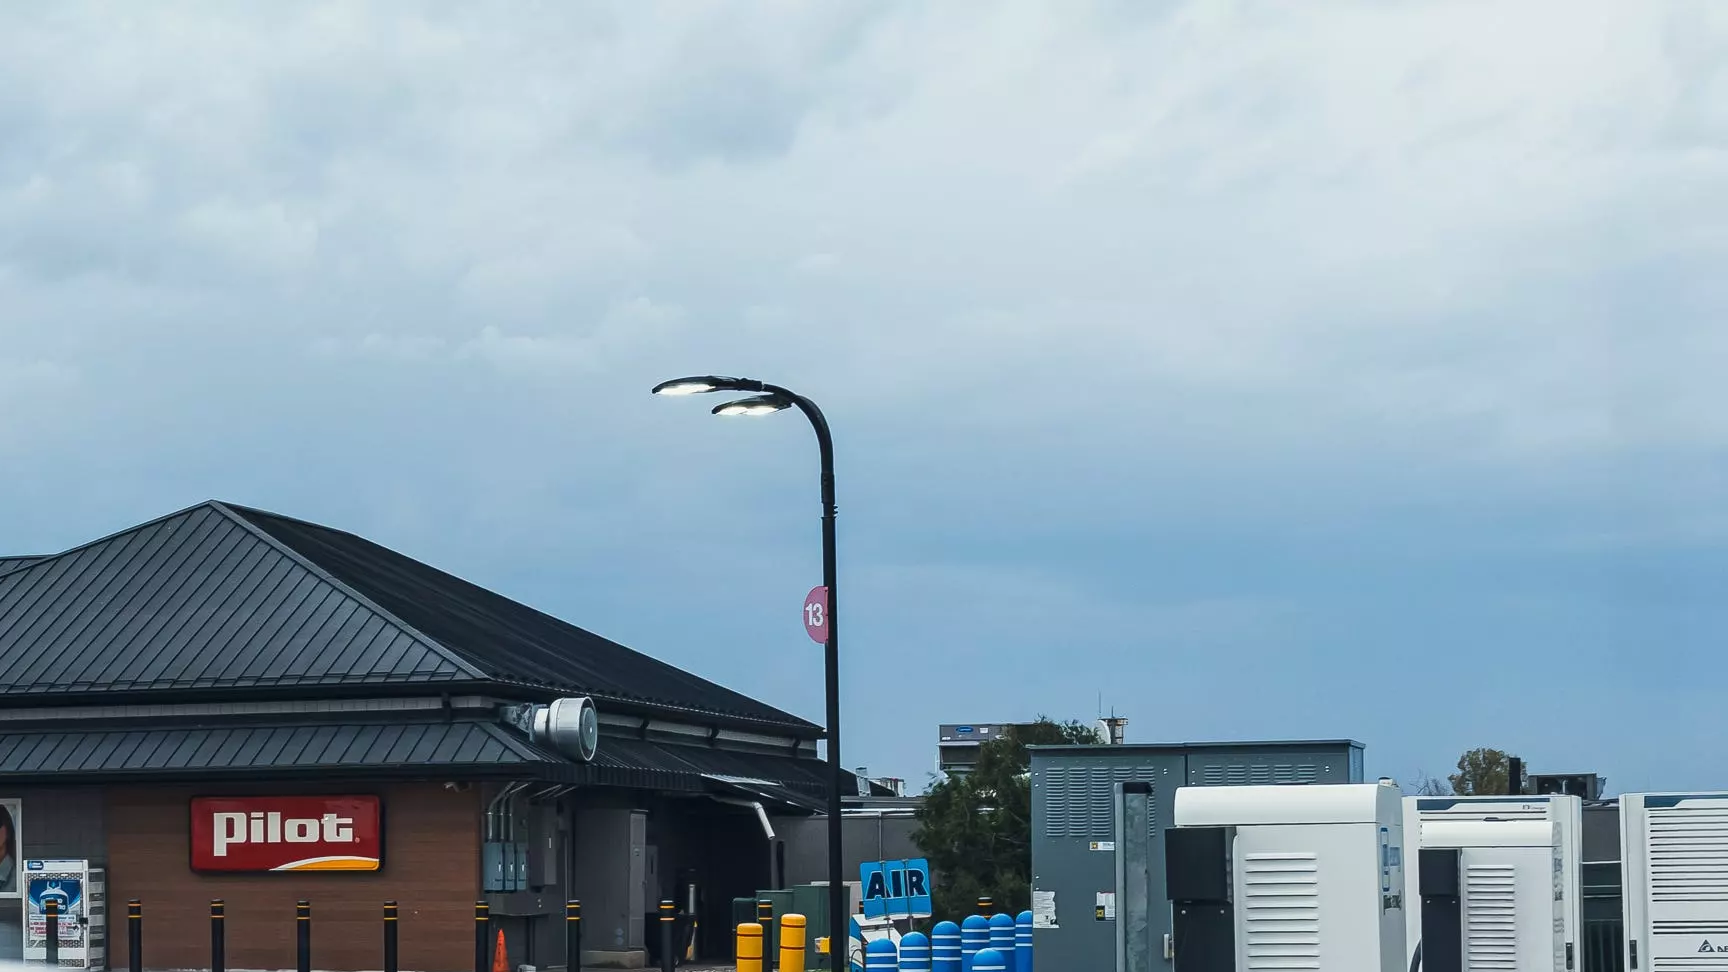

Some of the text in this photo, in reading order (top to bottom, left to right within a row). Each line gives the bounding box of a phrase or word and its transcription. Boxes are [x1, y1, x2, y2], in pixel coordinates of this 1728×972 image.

[805, 603, 824, 627] 13
[213, 811, 353, 857] Pilot
[865, 868, 929, 900] AIR
